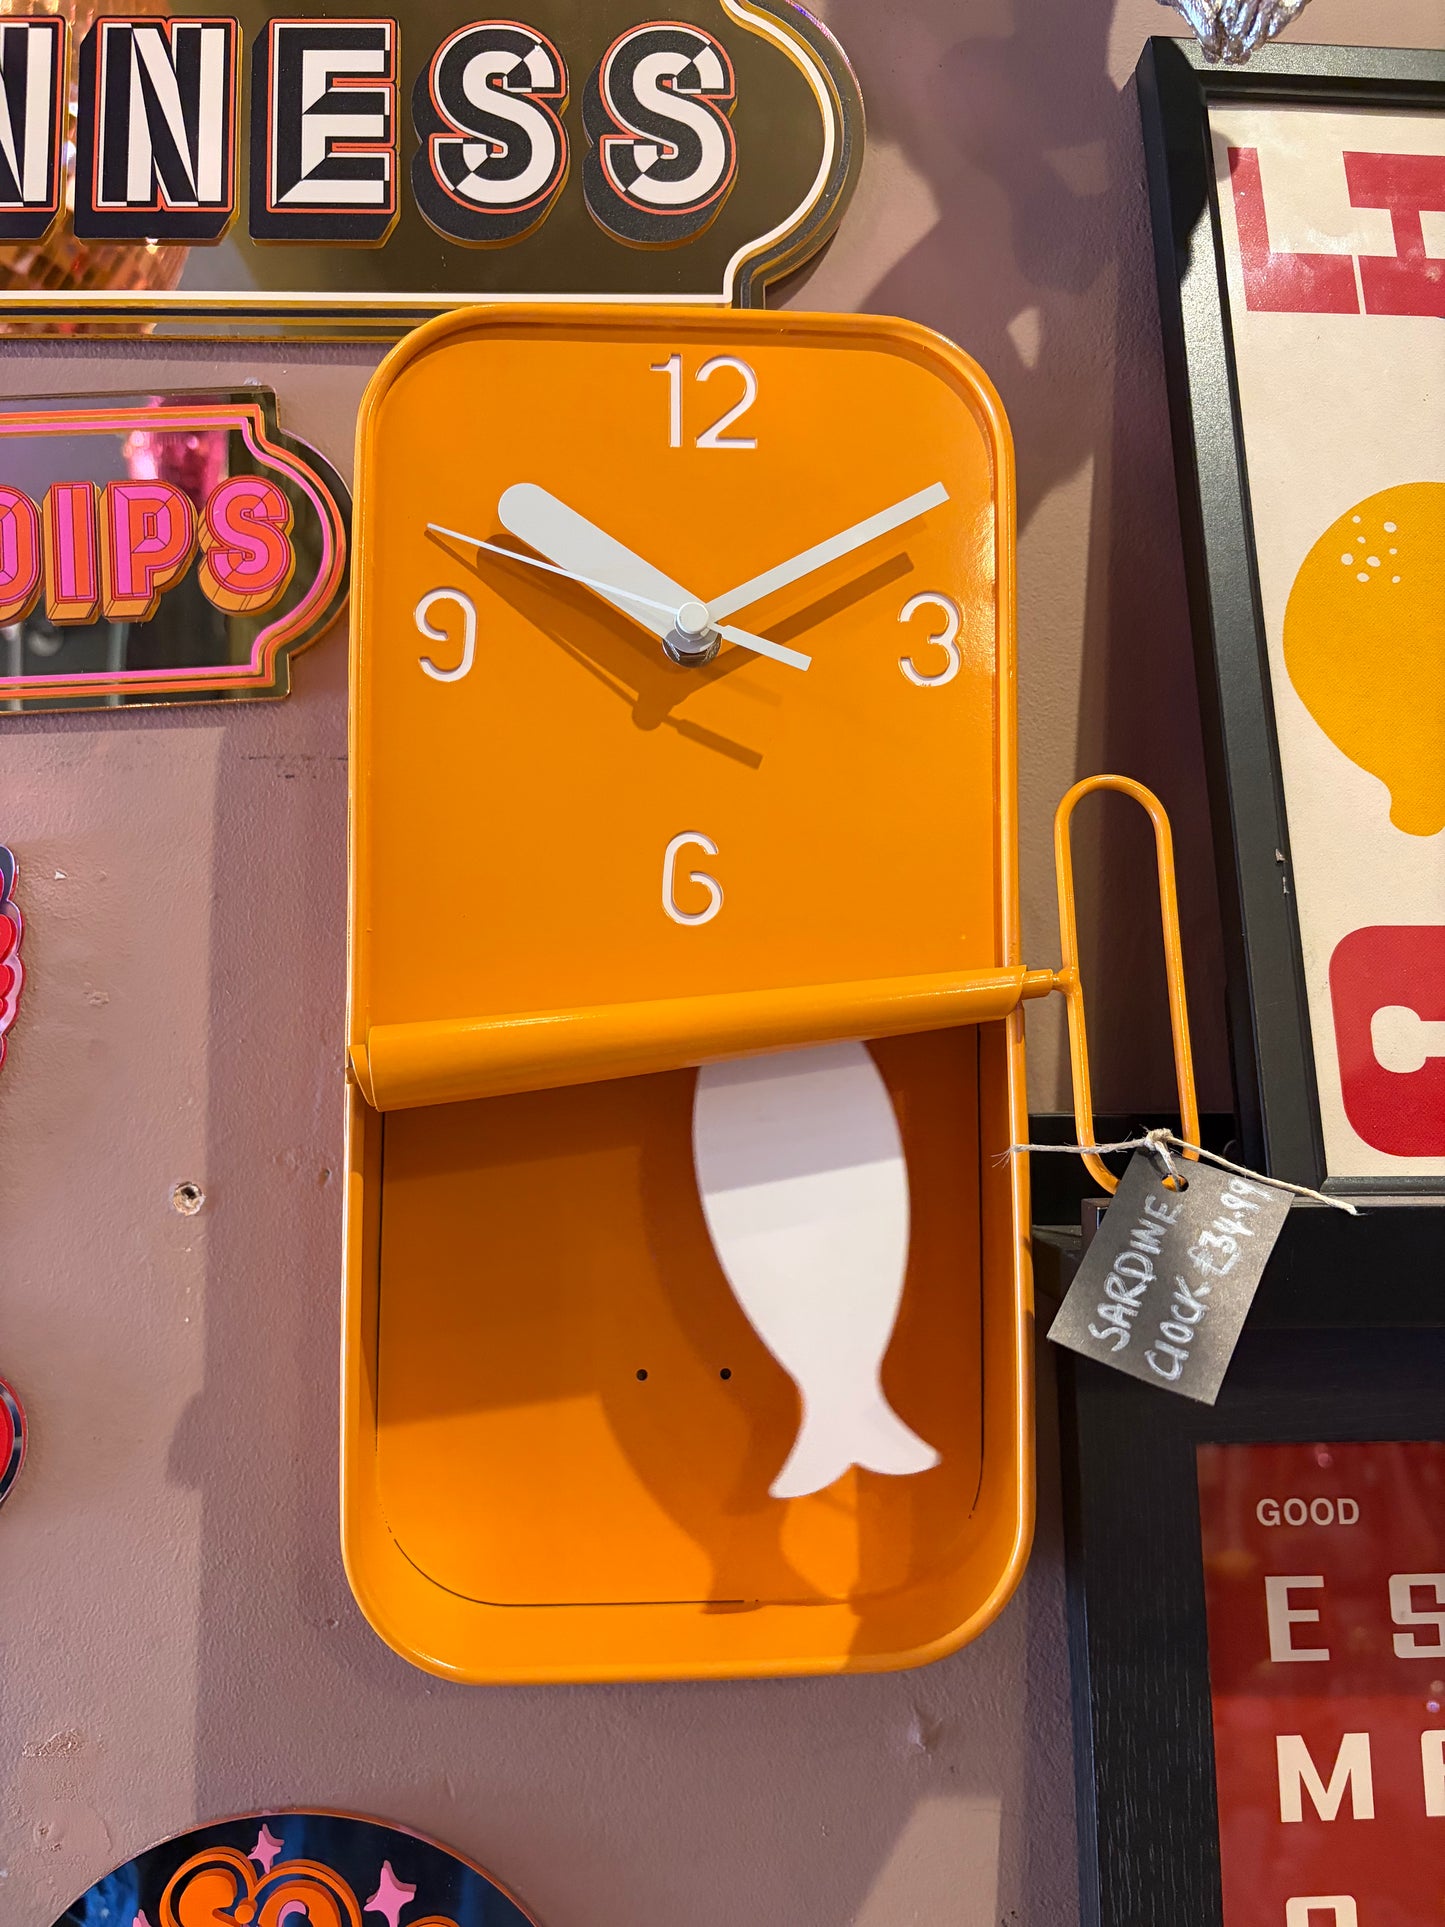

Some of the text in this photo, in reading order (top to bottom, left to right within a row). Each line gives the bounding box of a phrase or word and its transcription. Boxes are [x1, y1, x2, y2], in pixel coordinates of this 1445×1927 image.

[649, 353, 759, 449] 12
[415, 587, 478, 683] 9
[898, 592, 962, 688] 3
[661, 830, 724, 927] 6
[1088, 1193, 1184, 1353] SARDINE
[1186, 1177, 1275, 1278] £34.99
[1256, 1497, 1360, 1527] GOOD
